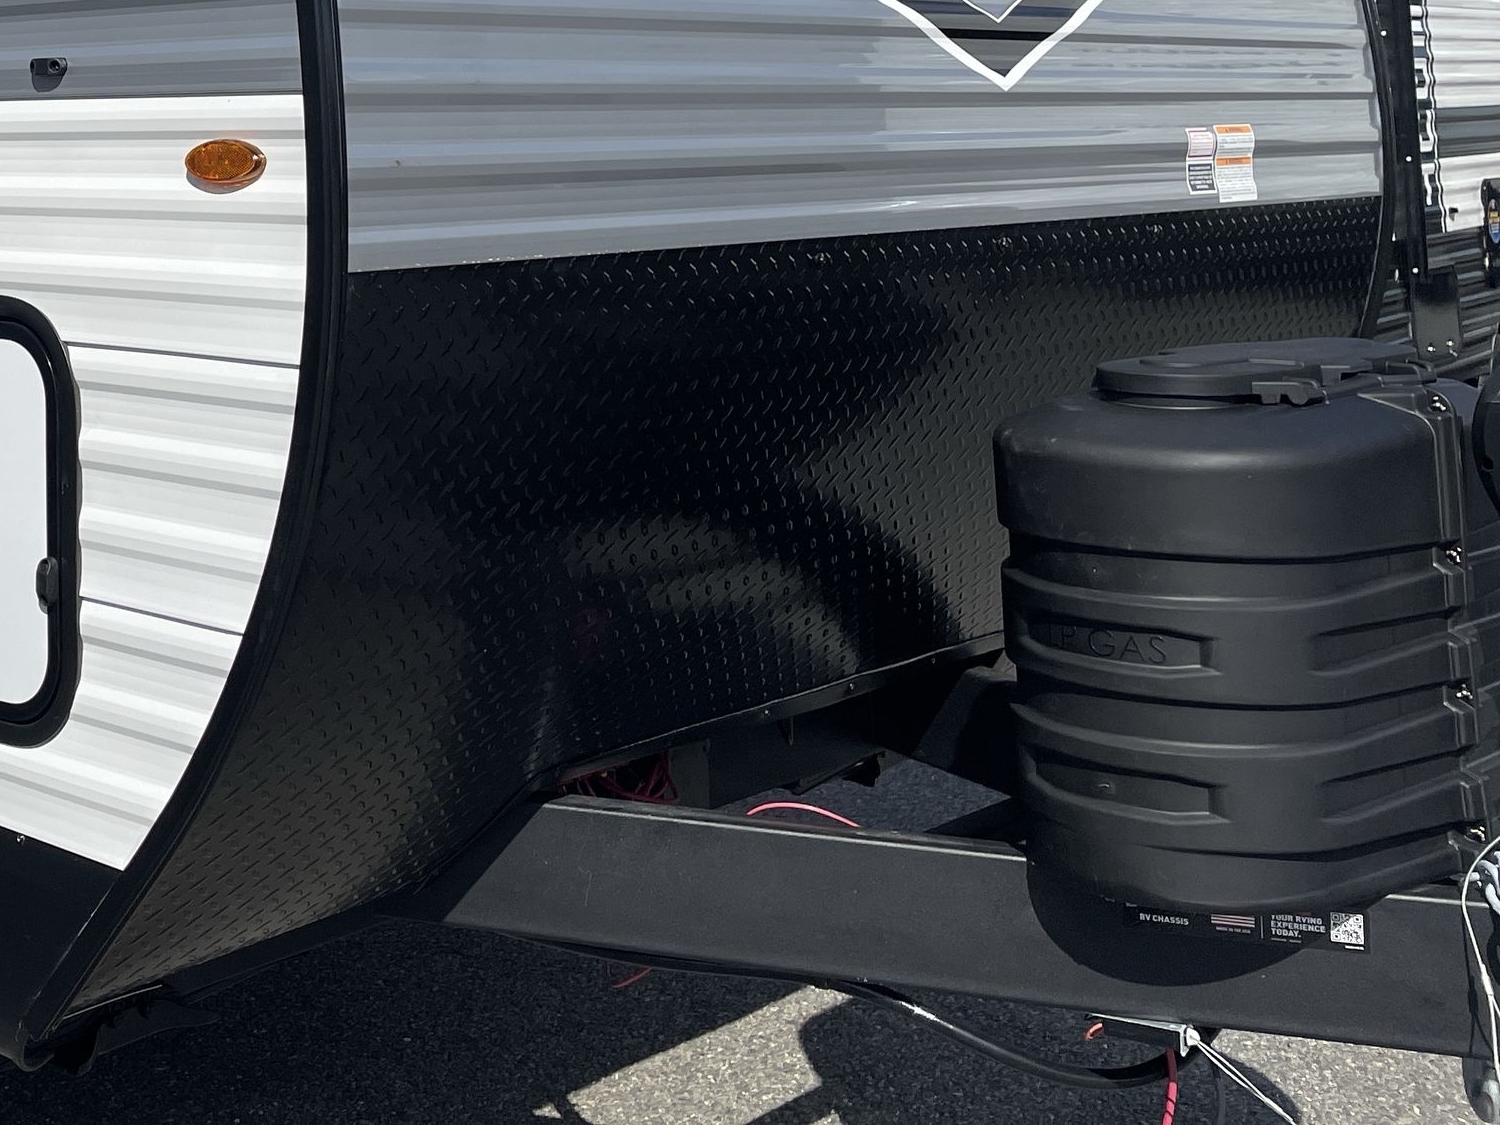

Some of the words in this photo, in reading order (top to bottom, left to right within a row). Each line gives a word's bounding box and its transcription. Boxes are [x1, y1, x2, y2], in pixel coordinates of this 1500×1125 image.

[1088, 630, 1167, 664] GAS
[1152, 915, 1189, 926] CHASSIS
[1270, 920, 1326, 933] EXPERIENCE
[1270, 928, 1302, 938] TODAY.
